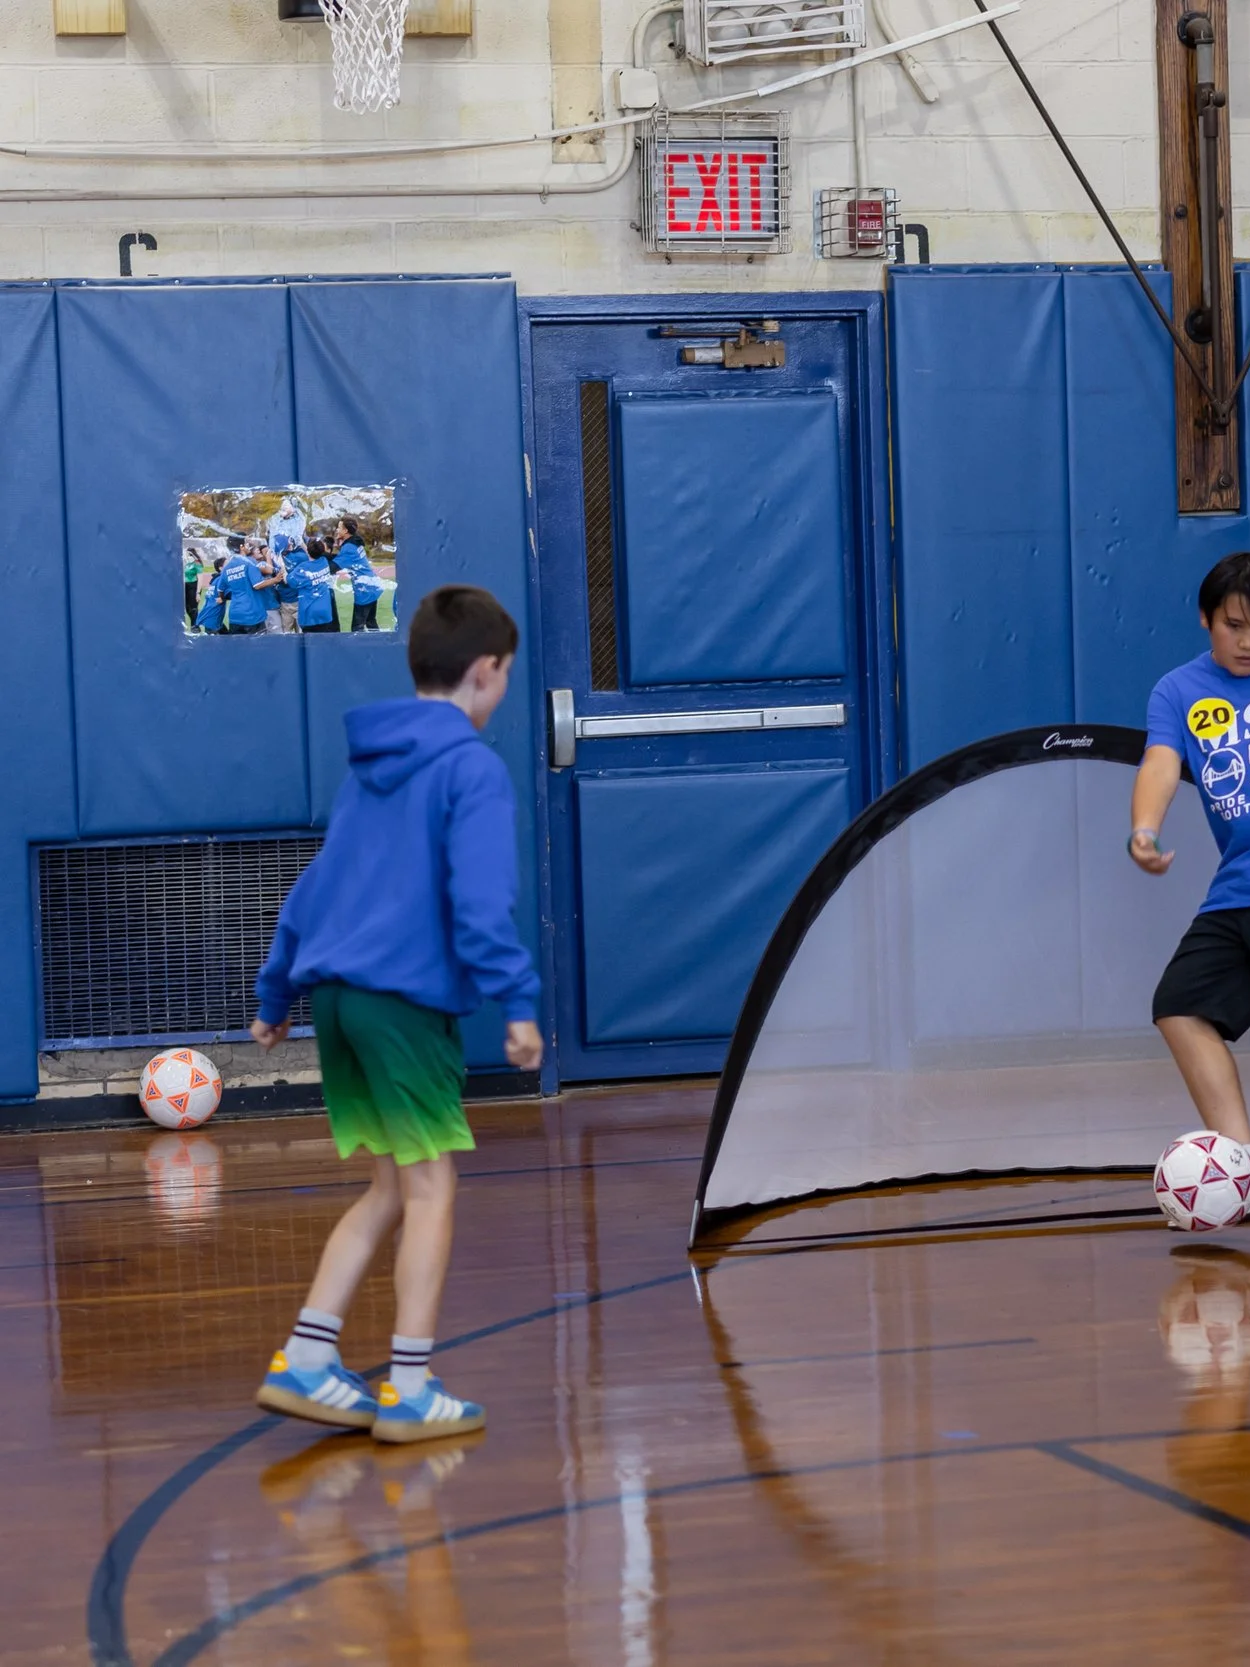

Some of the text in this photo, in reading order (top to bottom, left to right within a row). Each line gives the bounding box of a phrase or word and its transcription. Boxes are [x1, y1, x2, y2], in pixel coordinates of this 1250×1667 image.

[663, 153, 768, 232] EXIT
[861, 220, 881, 229] FIRE
[1193, 706, 1230, 733] 20
[1210, 793, 1246, 814] PRIDE
